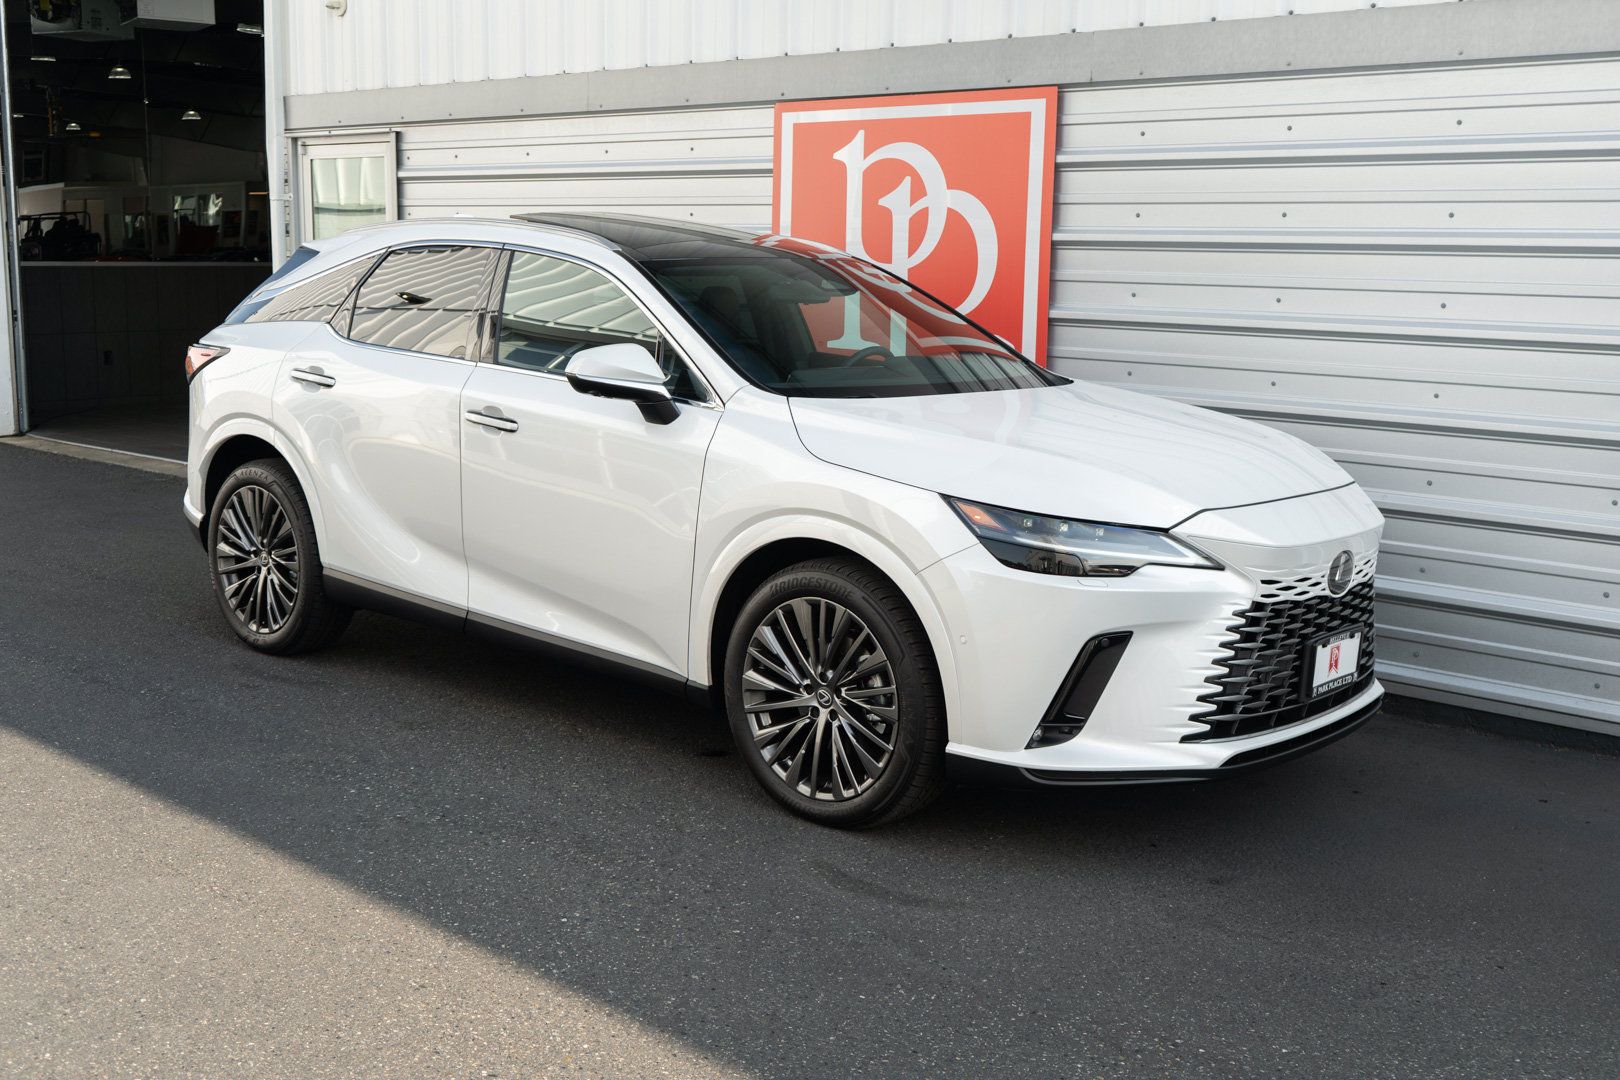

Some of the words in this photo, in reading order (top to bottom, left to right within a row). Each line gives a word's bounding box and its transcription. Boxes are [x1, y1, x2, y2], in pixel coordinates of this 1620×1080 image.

[770, 576, 856, 599] BRIDGESTONE
[1317, 683, 1329, 695] PARK
[1329, 678, 1342, 690] PLACE
[1342, 675, 1353, 685] LTD
